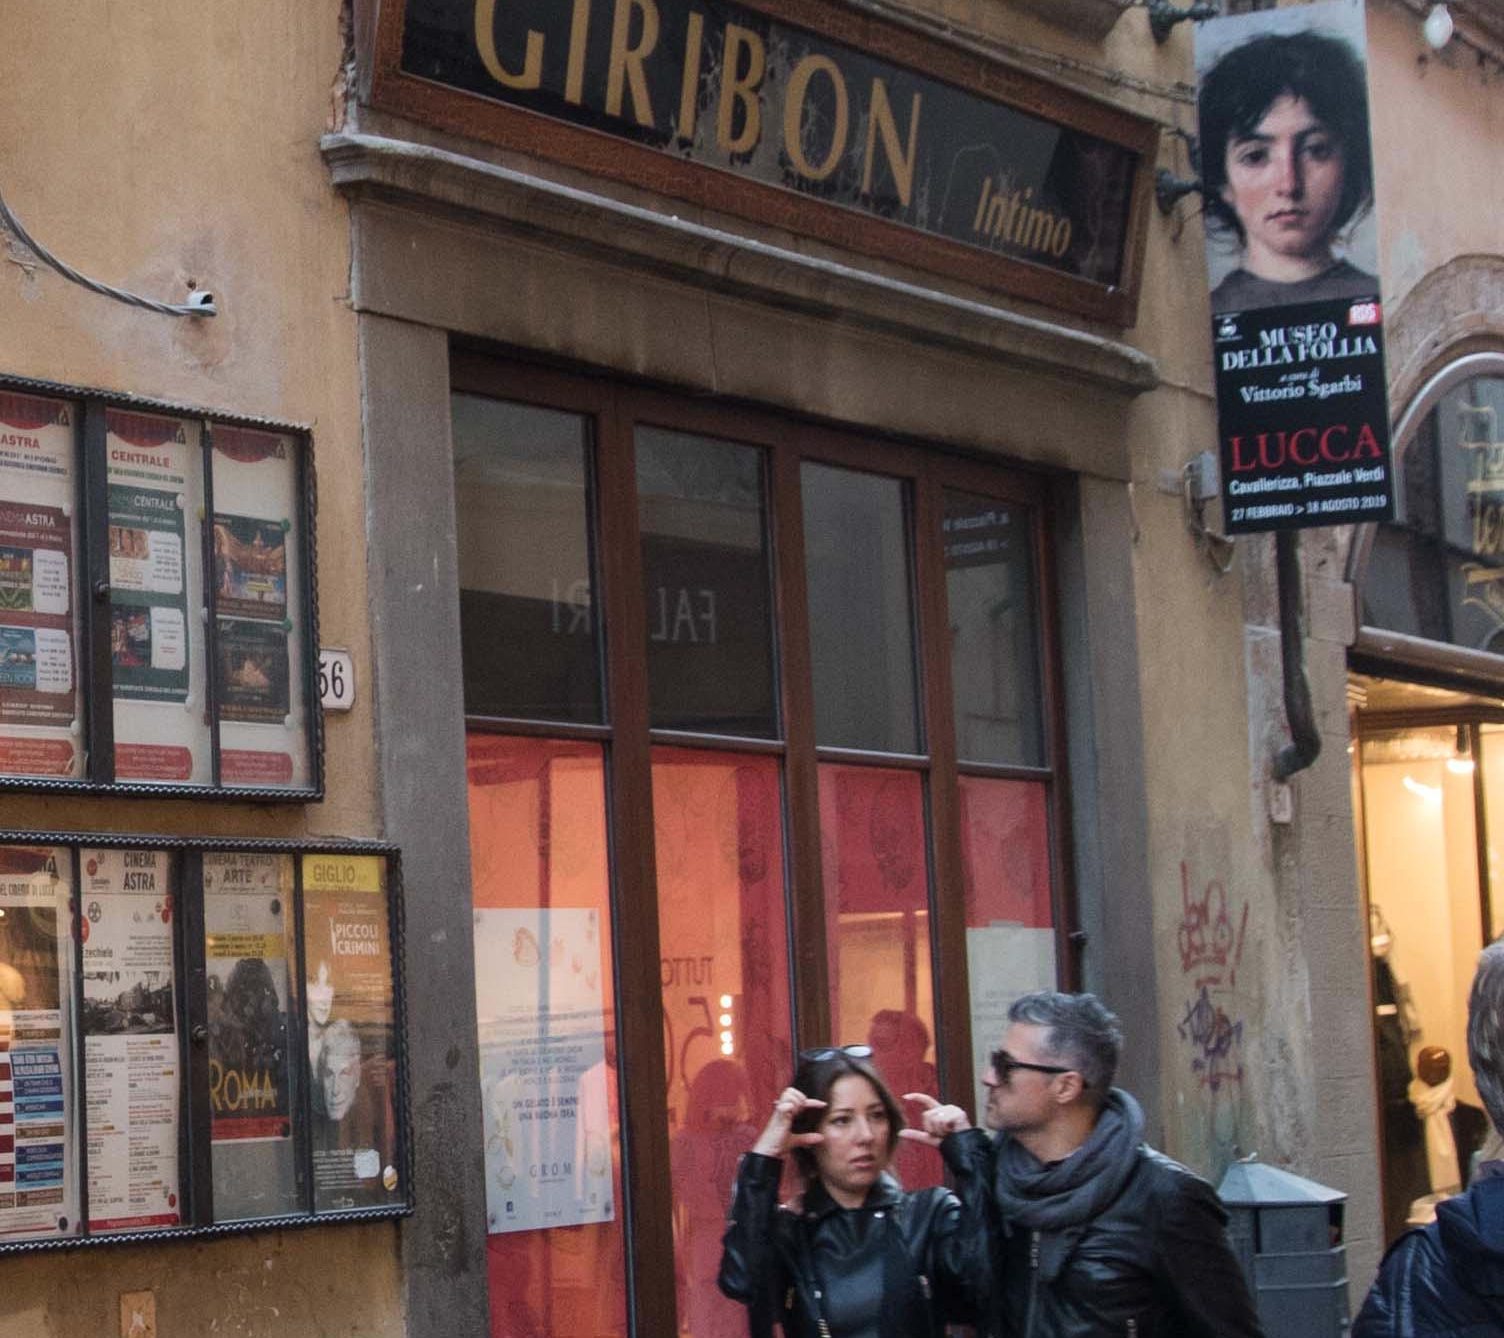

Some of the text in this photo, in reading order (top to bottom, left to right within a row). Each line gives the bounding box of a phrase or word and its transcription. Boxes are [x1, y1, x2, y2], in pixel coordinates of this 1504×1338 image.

[973, 176, 1072, 257] Intimo
[1259, 322, 1337, 349] MUSEO
[1222, 336, 1377, 371] DELLA FOLLIA
[1240, 374, 1361, 404] Vittorio Sgarbi
[0, 433, 40, 449] ASTRA
[1229, 422, 1382, 471] LUCCA
[111, 450, 171, 468] CENTRALE
[1229, 465, 1384, 495] Cavallerizza, Piazzale Verdi
[134, 495, 175, 510] CENTRALE
[1232, 507, 1244, 521] 27
[1245, 504, 1294, 520] FEBBRAIO
[1321, 497, 1359, 511] AGOSTO
[1360, 494, 1387, 509] 2019
[25, 513, 55, 527] ASTRA
[123, 852, 157, 868] CINEMA
[123, 872, 155, 890] ASTRA
[223, 869, 253, 883] ARTE
[313, 865, 355, 883] GIGLIO
[335, 925, 378, 939] PICCOLI
[336, 941, 380, 955] CRIMINI
[208, 1059, 276, 1110] ROMA
